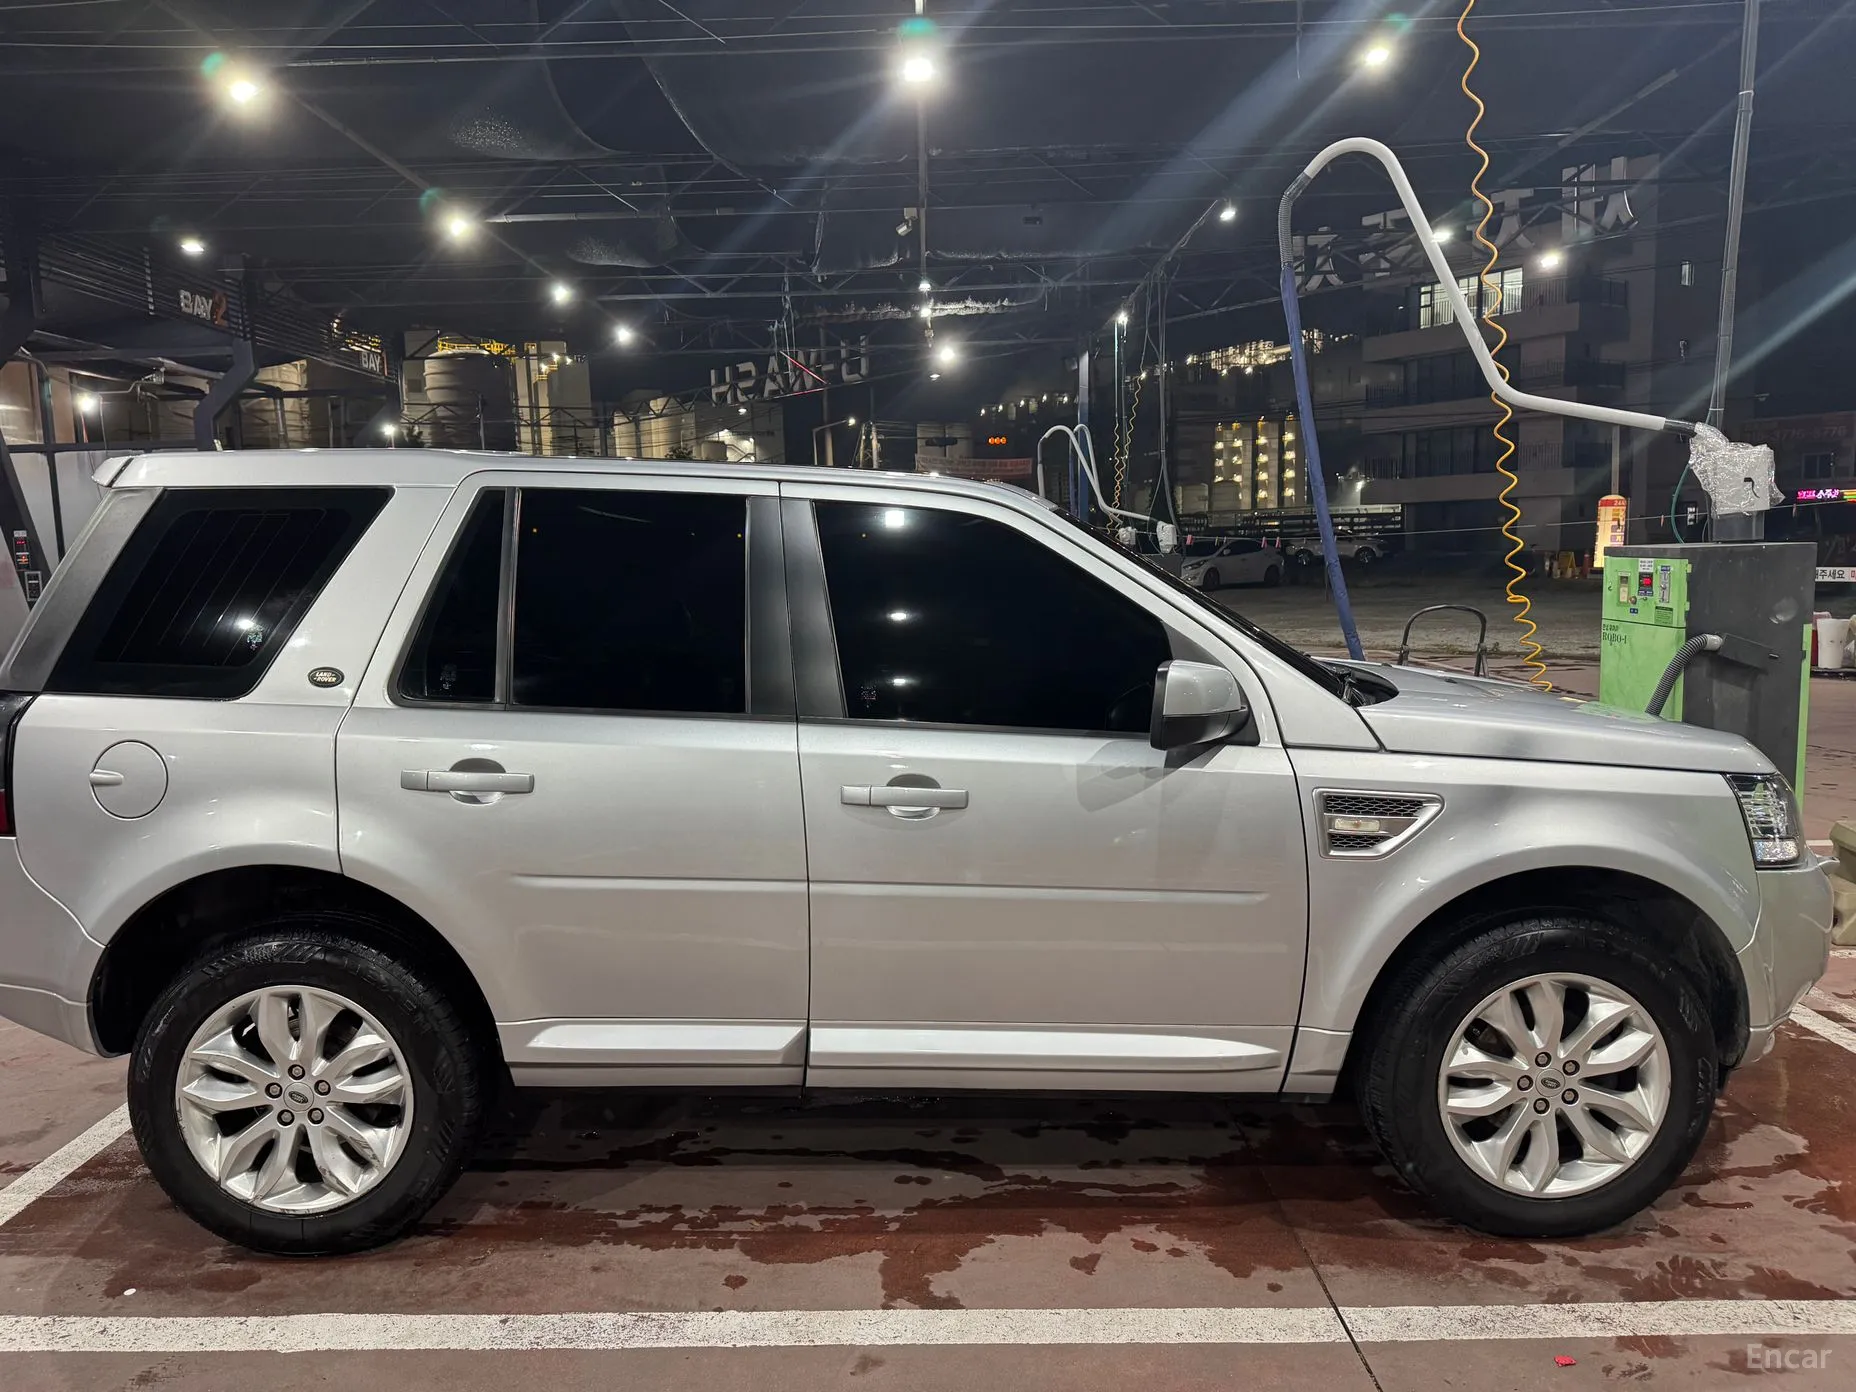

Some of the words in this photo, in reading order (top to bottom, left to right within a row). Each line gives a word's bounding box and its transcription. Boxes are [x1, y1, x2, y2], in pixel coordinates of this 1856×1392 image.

[179, 289, 213, 321] BAY
[213, 291, 228, 327] 2
[361, 351, 381, 373] BAY
